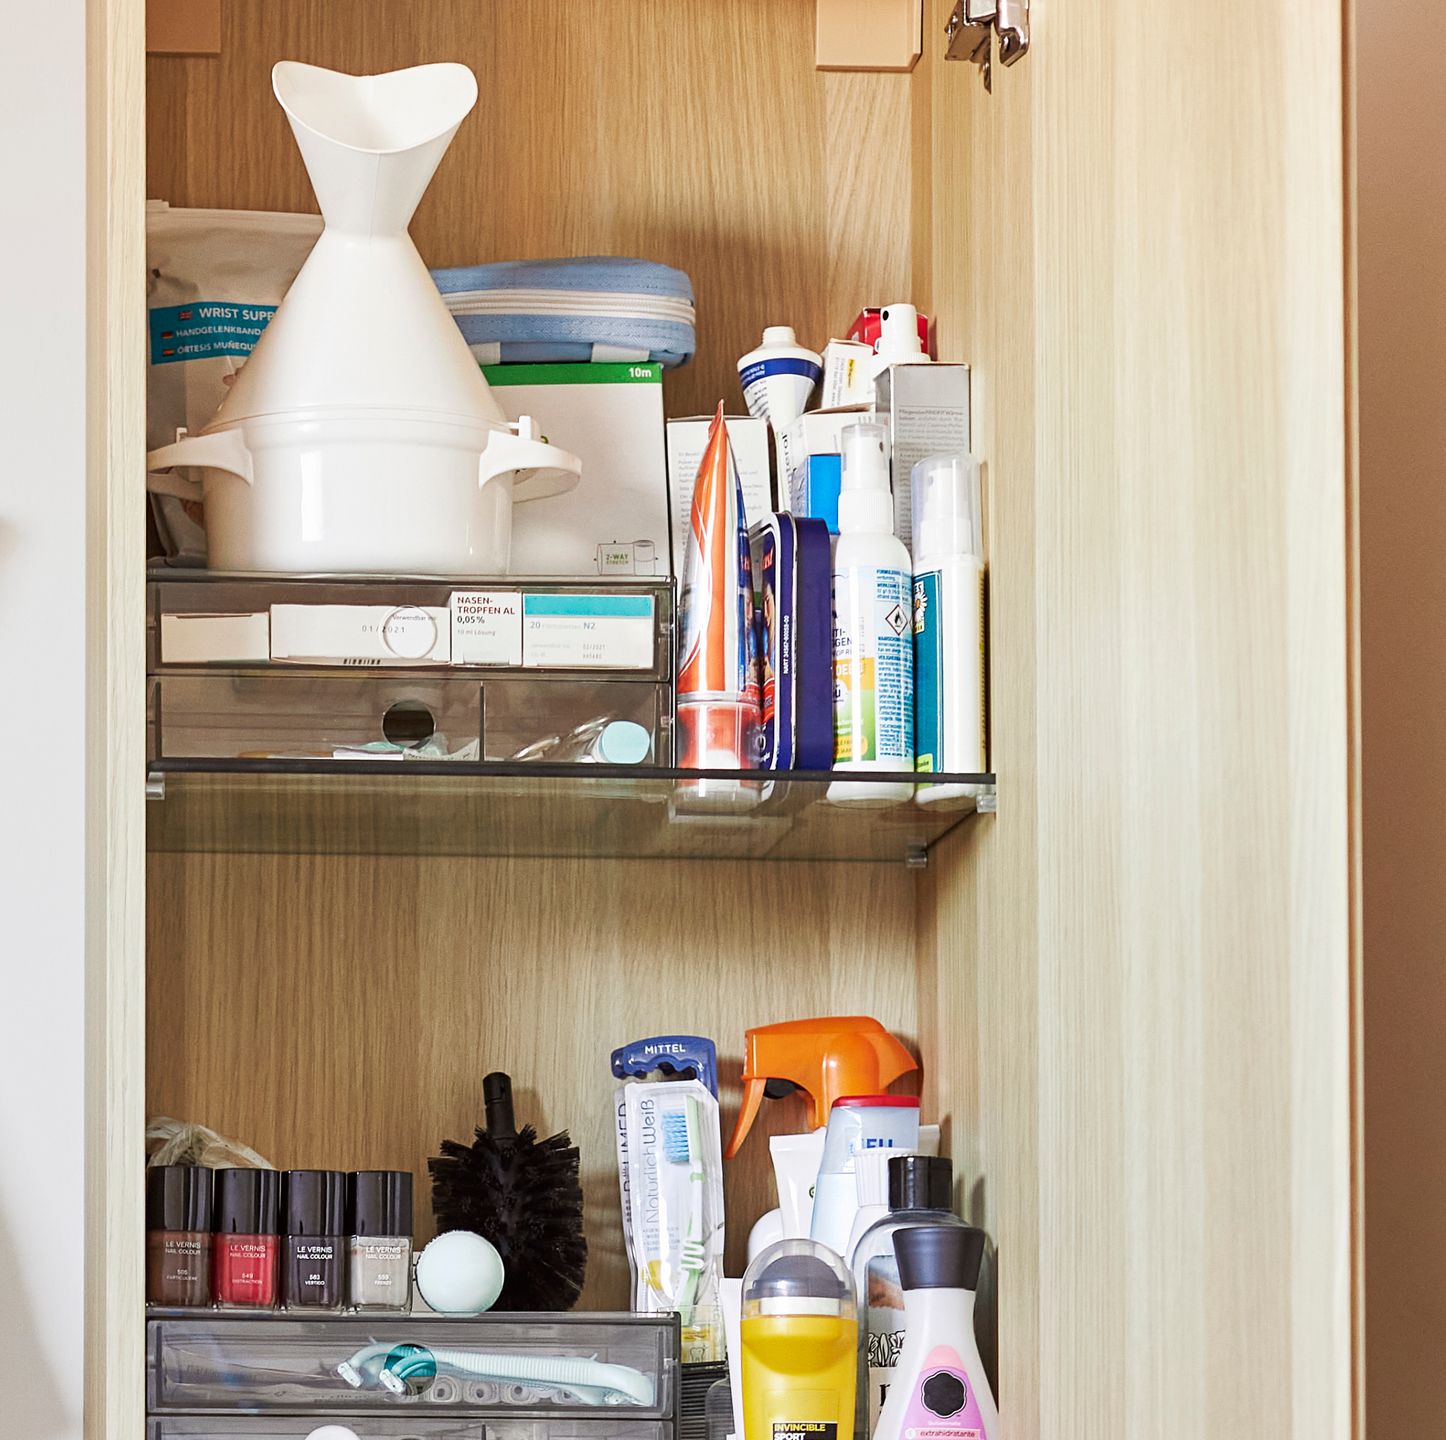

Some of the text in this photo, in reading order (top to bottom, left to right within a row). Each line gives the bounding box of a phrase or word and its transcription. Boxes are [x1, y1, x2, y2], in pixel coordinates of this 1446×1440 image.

[199, 308, 238, 319] WRIST
[629, 367, 652, 377] 10m
[457, 596, 493, 605] NASEN-
[457, 606, 516, 615] TROPFEN AL
[530, 621, 541, 630] 20
[583, 622, 596, 630] N2
[645, 1044, 686, 1054] MITTEL
[640, 1098, 658, 1224] NatürlichWeiß
[176, 1241, 201, 1249] VERNIS
[774, 1432, 806, 1440] SPORT
[920, 1430, 975, 1438] extrahidratante
